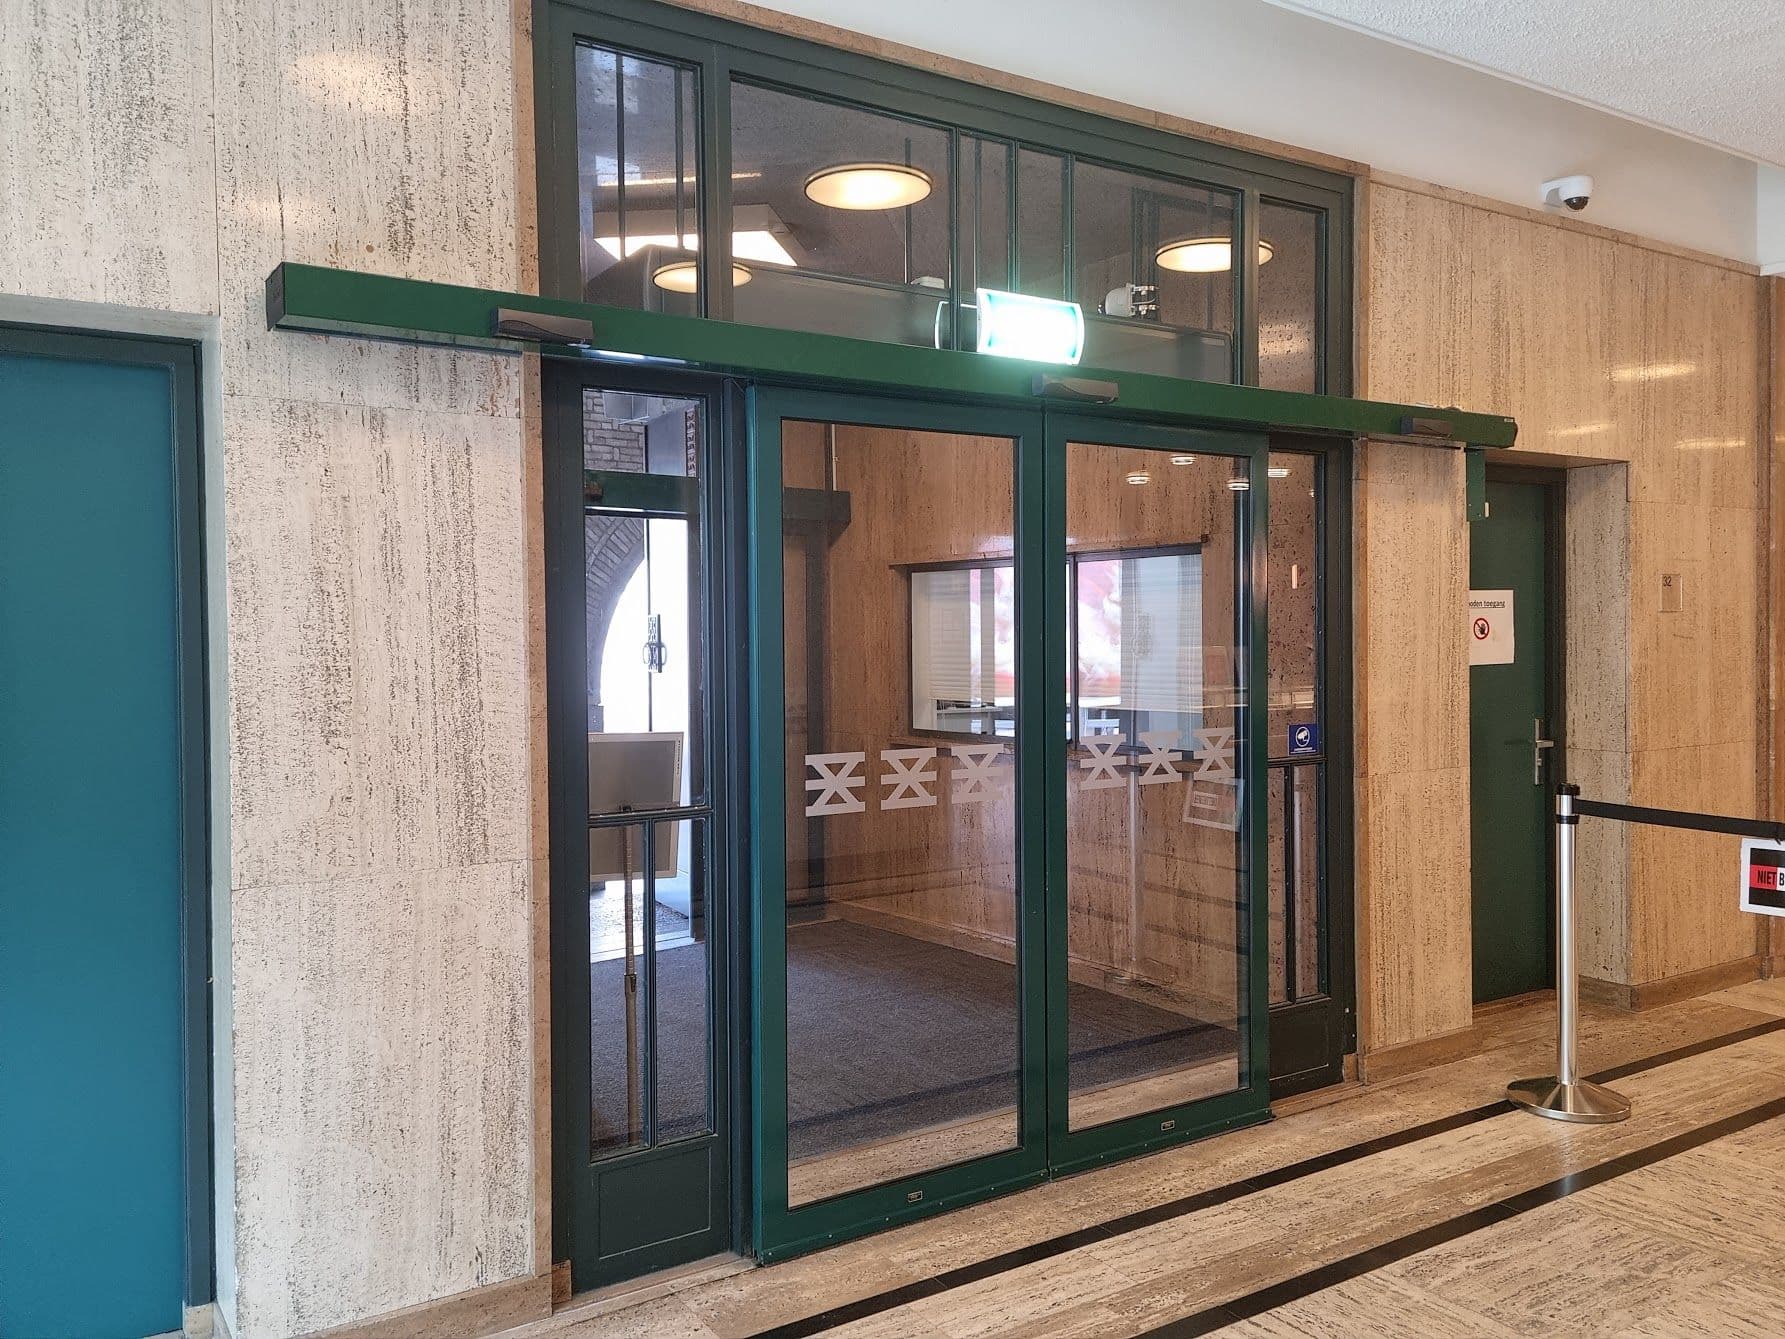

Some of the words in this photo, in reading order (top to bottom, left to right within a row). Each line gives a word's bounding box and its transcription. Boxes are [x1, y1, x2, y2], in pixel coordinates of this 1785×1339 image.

[1663, 576, 1672, 587] 32
[1483, 600, 1505, 608] toegang
[1757, 870, 1777, 885] NIET
